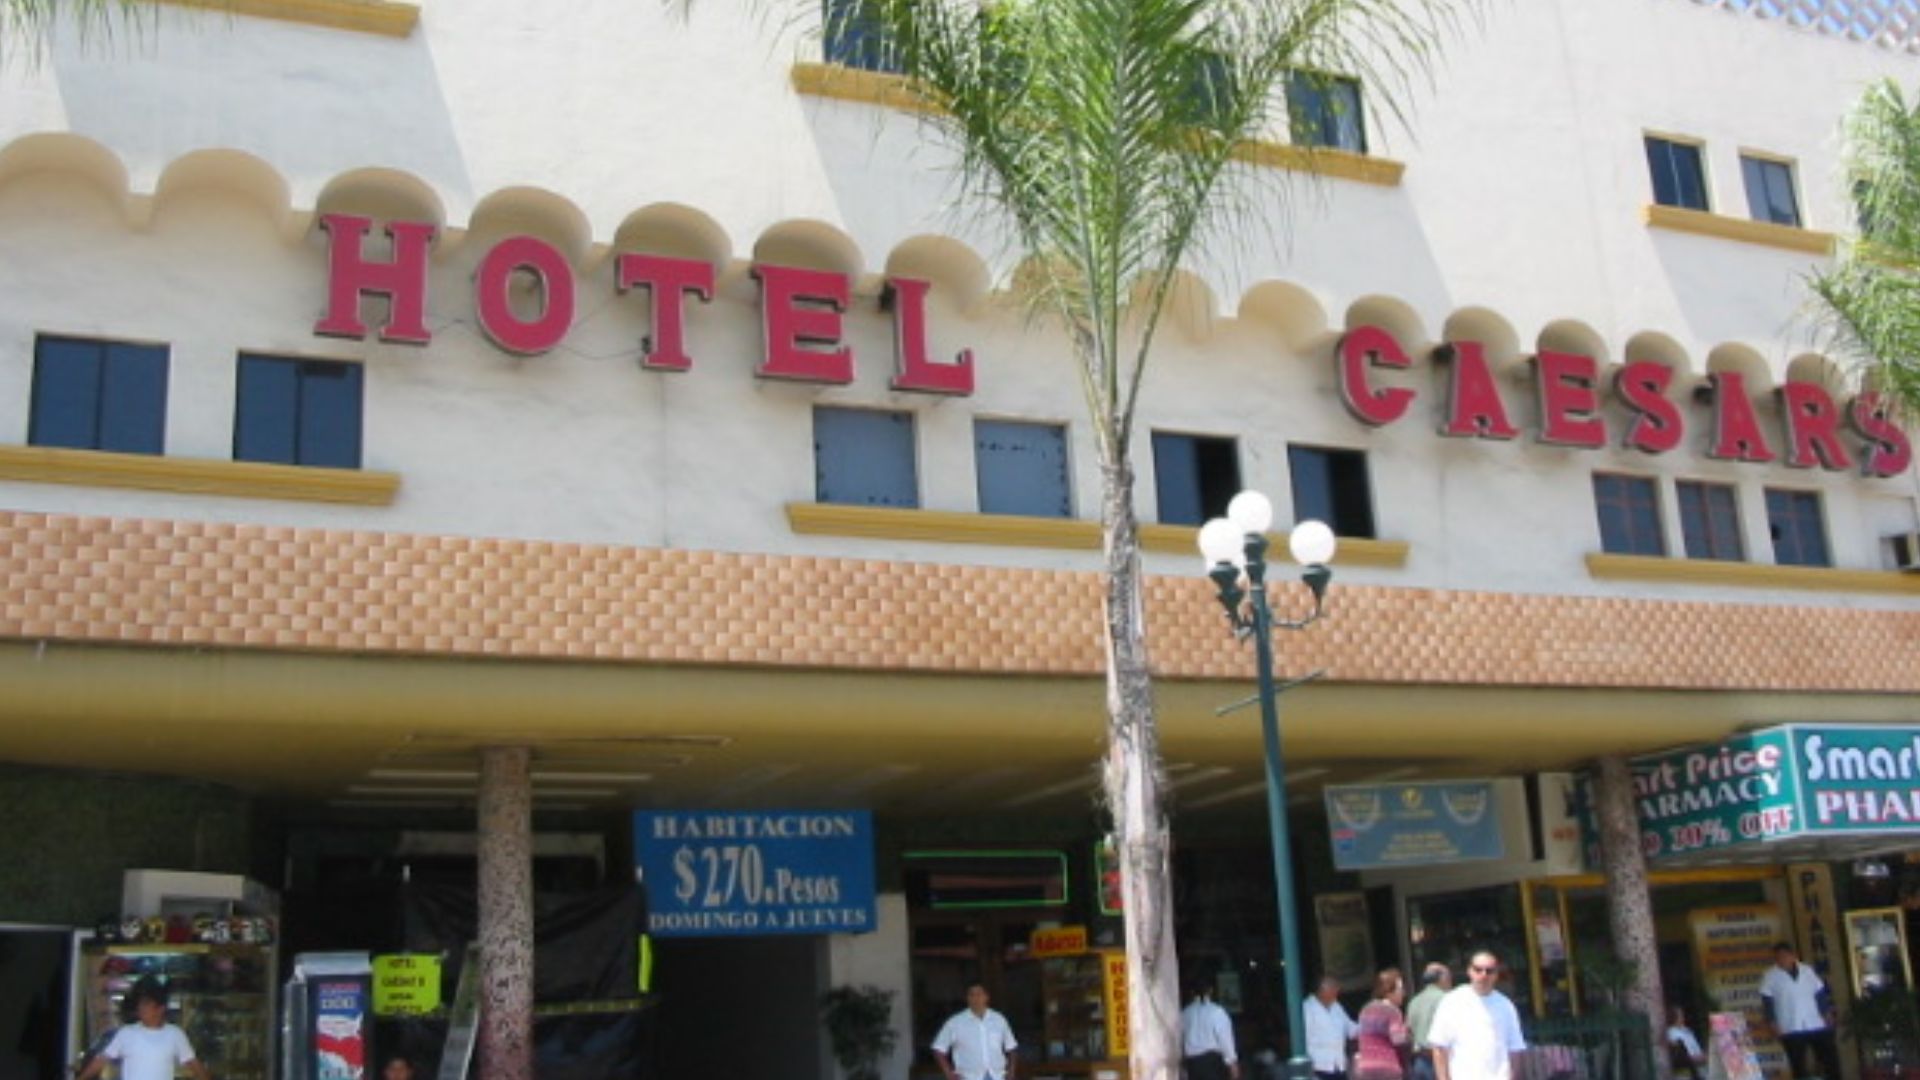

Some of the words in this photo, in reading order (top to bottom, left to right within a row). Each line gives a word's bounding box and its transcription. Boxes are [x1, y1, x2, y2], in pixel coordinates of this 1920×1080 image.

[313, 213, 974, 397] HOTEL
[1336, 324, 1912, 478] CAESARS
[1685, 744, 1782, 785] Price
[1641, 770, 1782, 821] ARMACY
[652, 815, 855, 839] HABITACION
[1739, 804, 1794, 839] OFF
[775, 866, 841, 904] Pesos
[649, 911, 759, 930] DOMINGO
[764, 911, 780, 926] A
[782, 907, 867, 927] JUEVES
